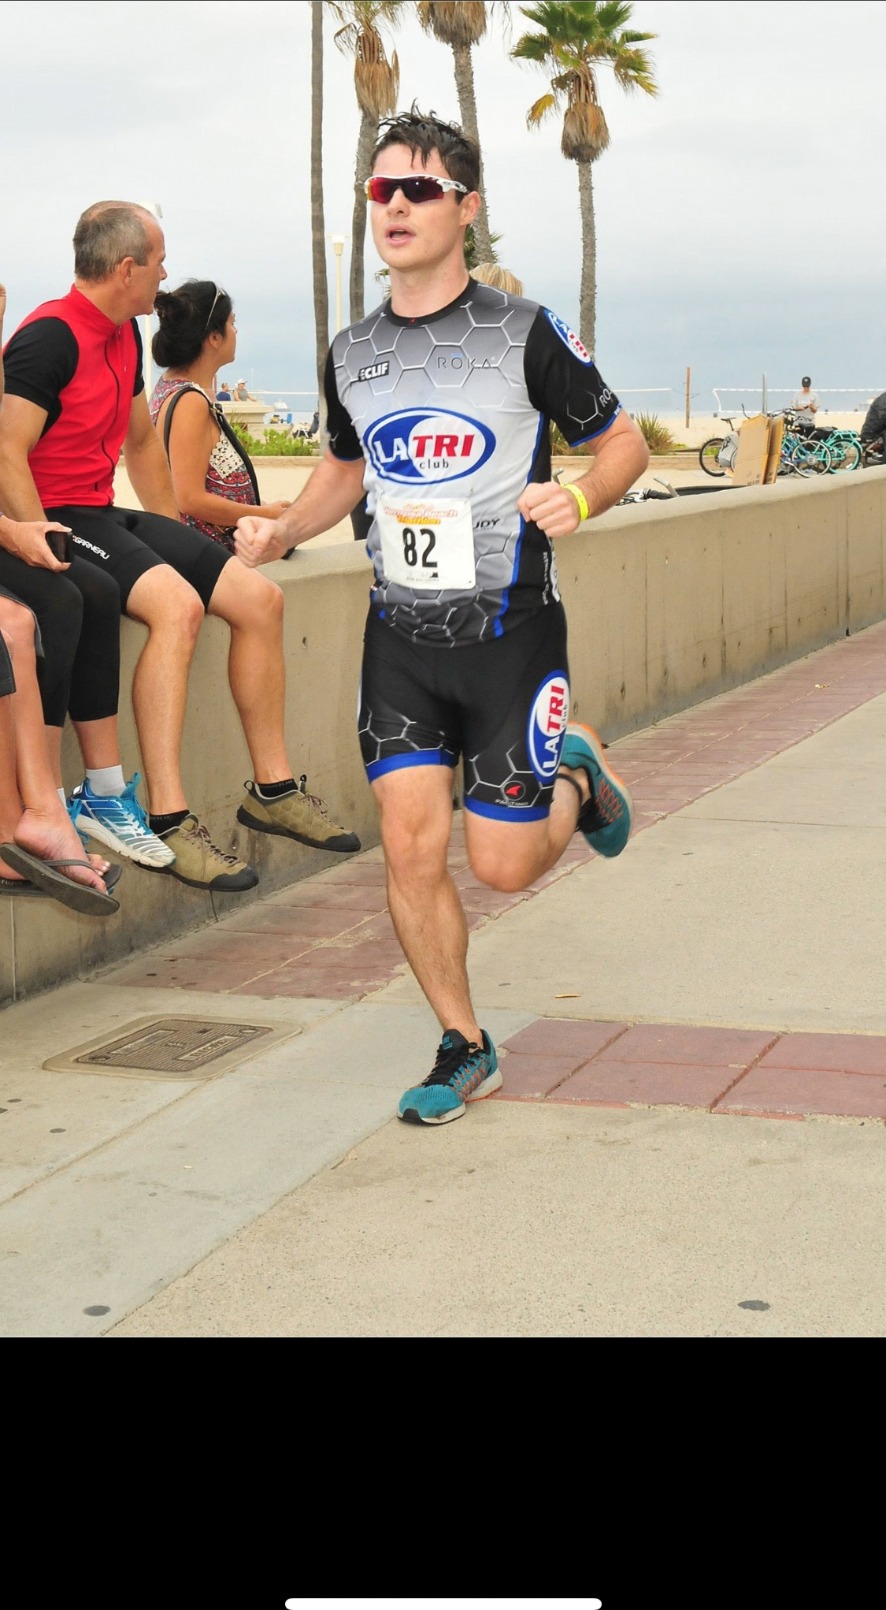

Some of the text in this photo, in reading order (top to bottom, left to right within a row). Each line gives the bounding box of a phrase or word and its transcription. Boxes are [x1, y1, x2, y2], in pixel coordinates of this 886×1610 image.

[364, 362, 389, 380] CLIF
[374, 434, 475, 463] LA TRI
[419, 459, 449, 469] club
[75, 537, 110, 560] GARNEAU
[402, 527, 438, 568] 82
[543, 685, 565, 769] LA TRI
